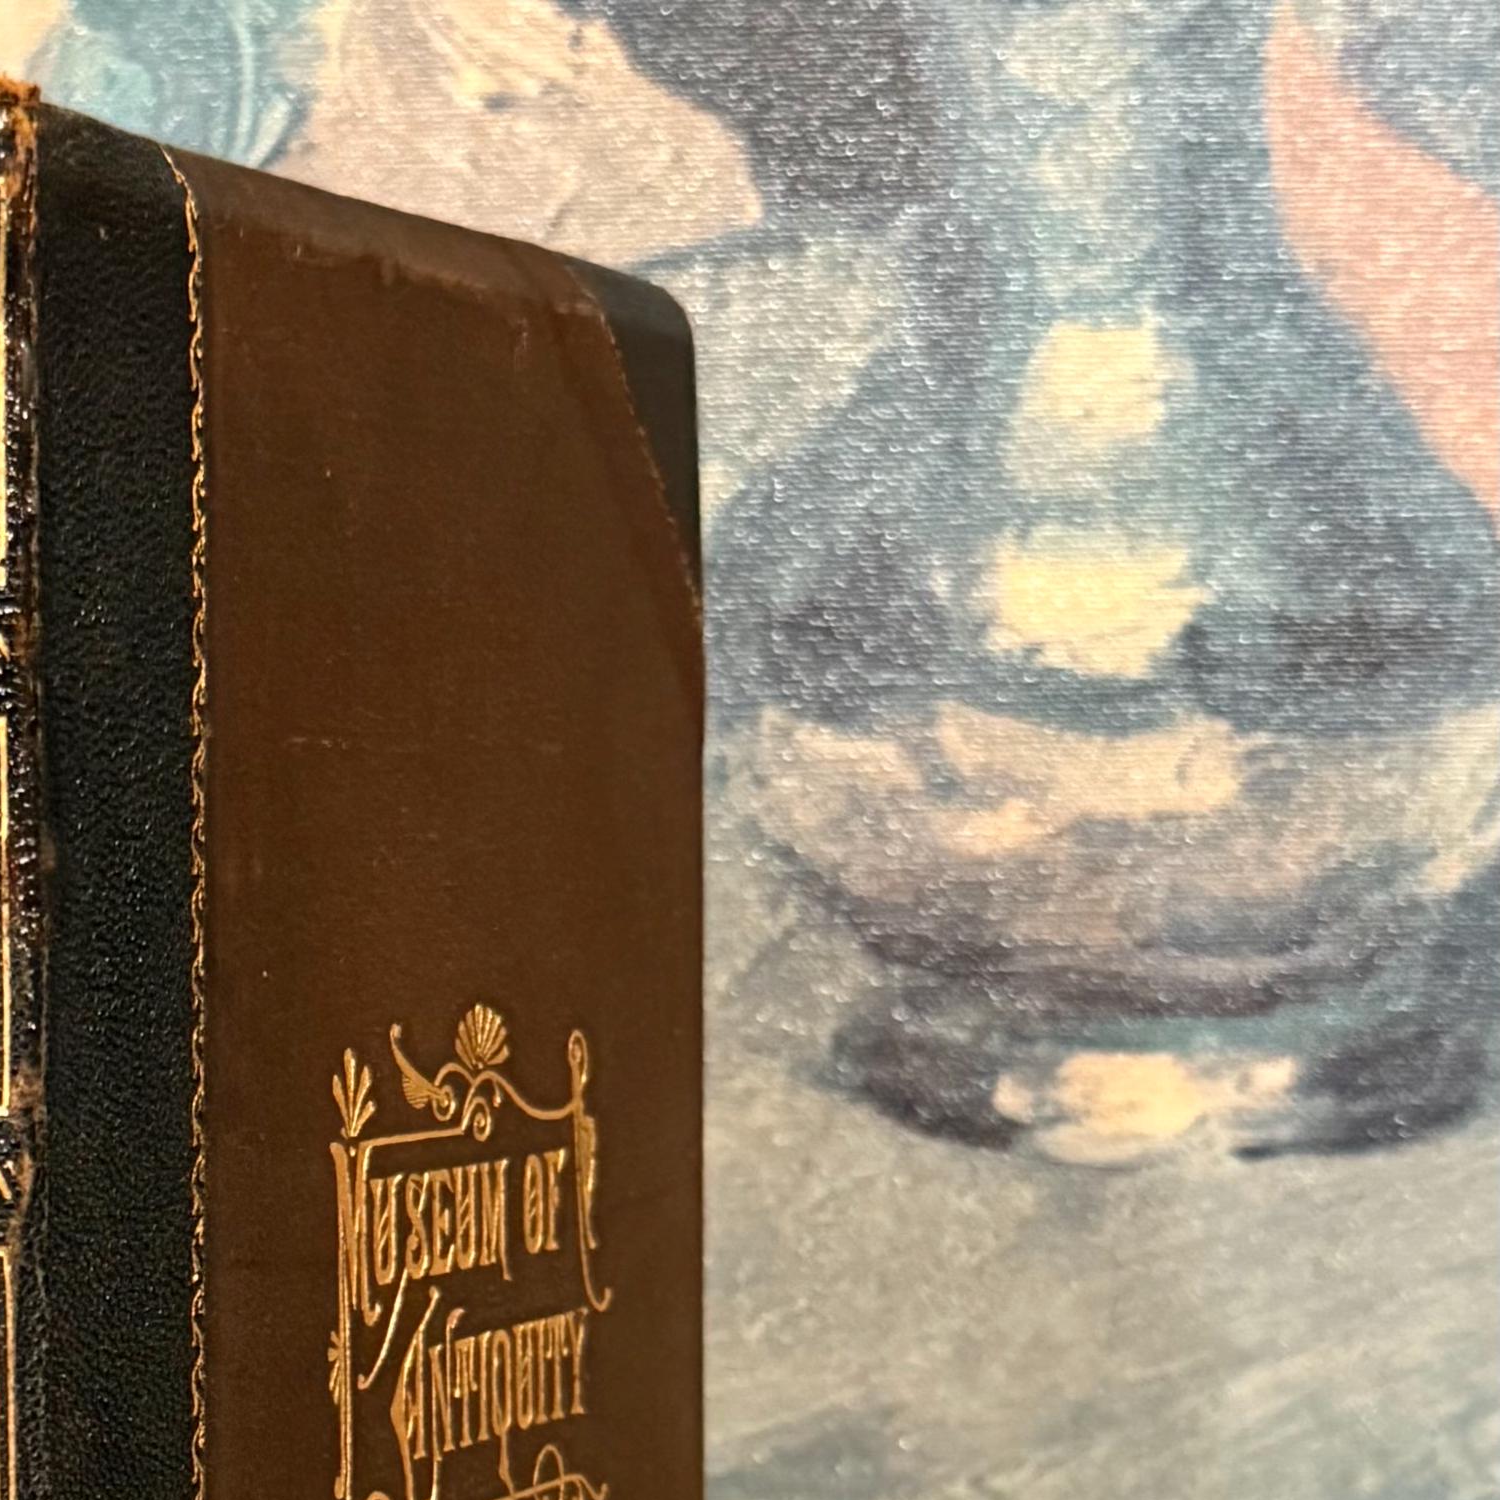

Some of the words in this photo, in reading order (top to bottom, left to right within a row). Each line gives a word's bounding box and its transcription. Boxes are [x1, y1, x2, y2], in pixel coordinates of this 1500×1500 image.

[332, 1142, 512, 1326] MUSEUM
[522, 1148, 566, 1254] OF
[390, 1300, 588, 1480] ANTIQUITY
